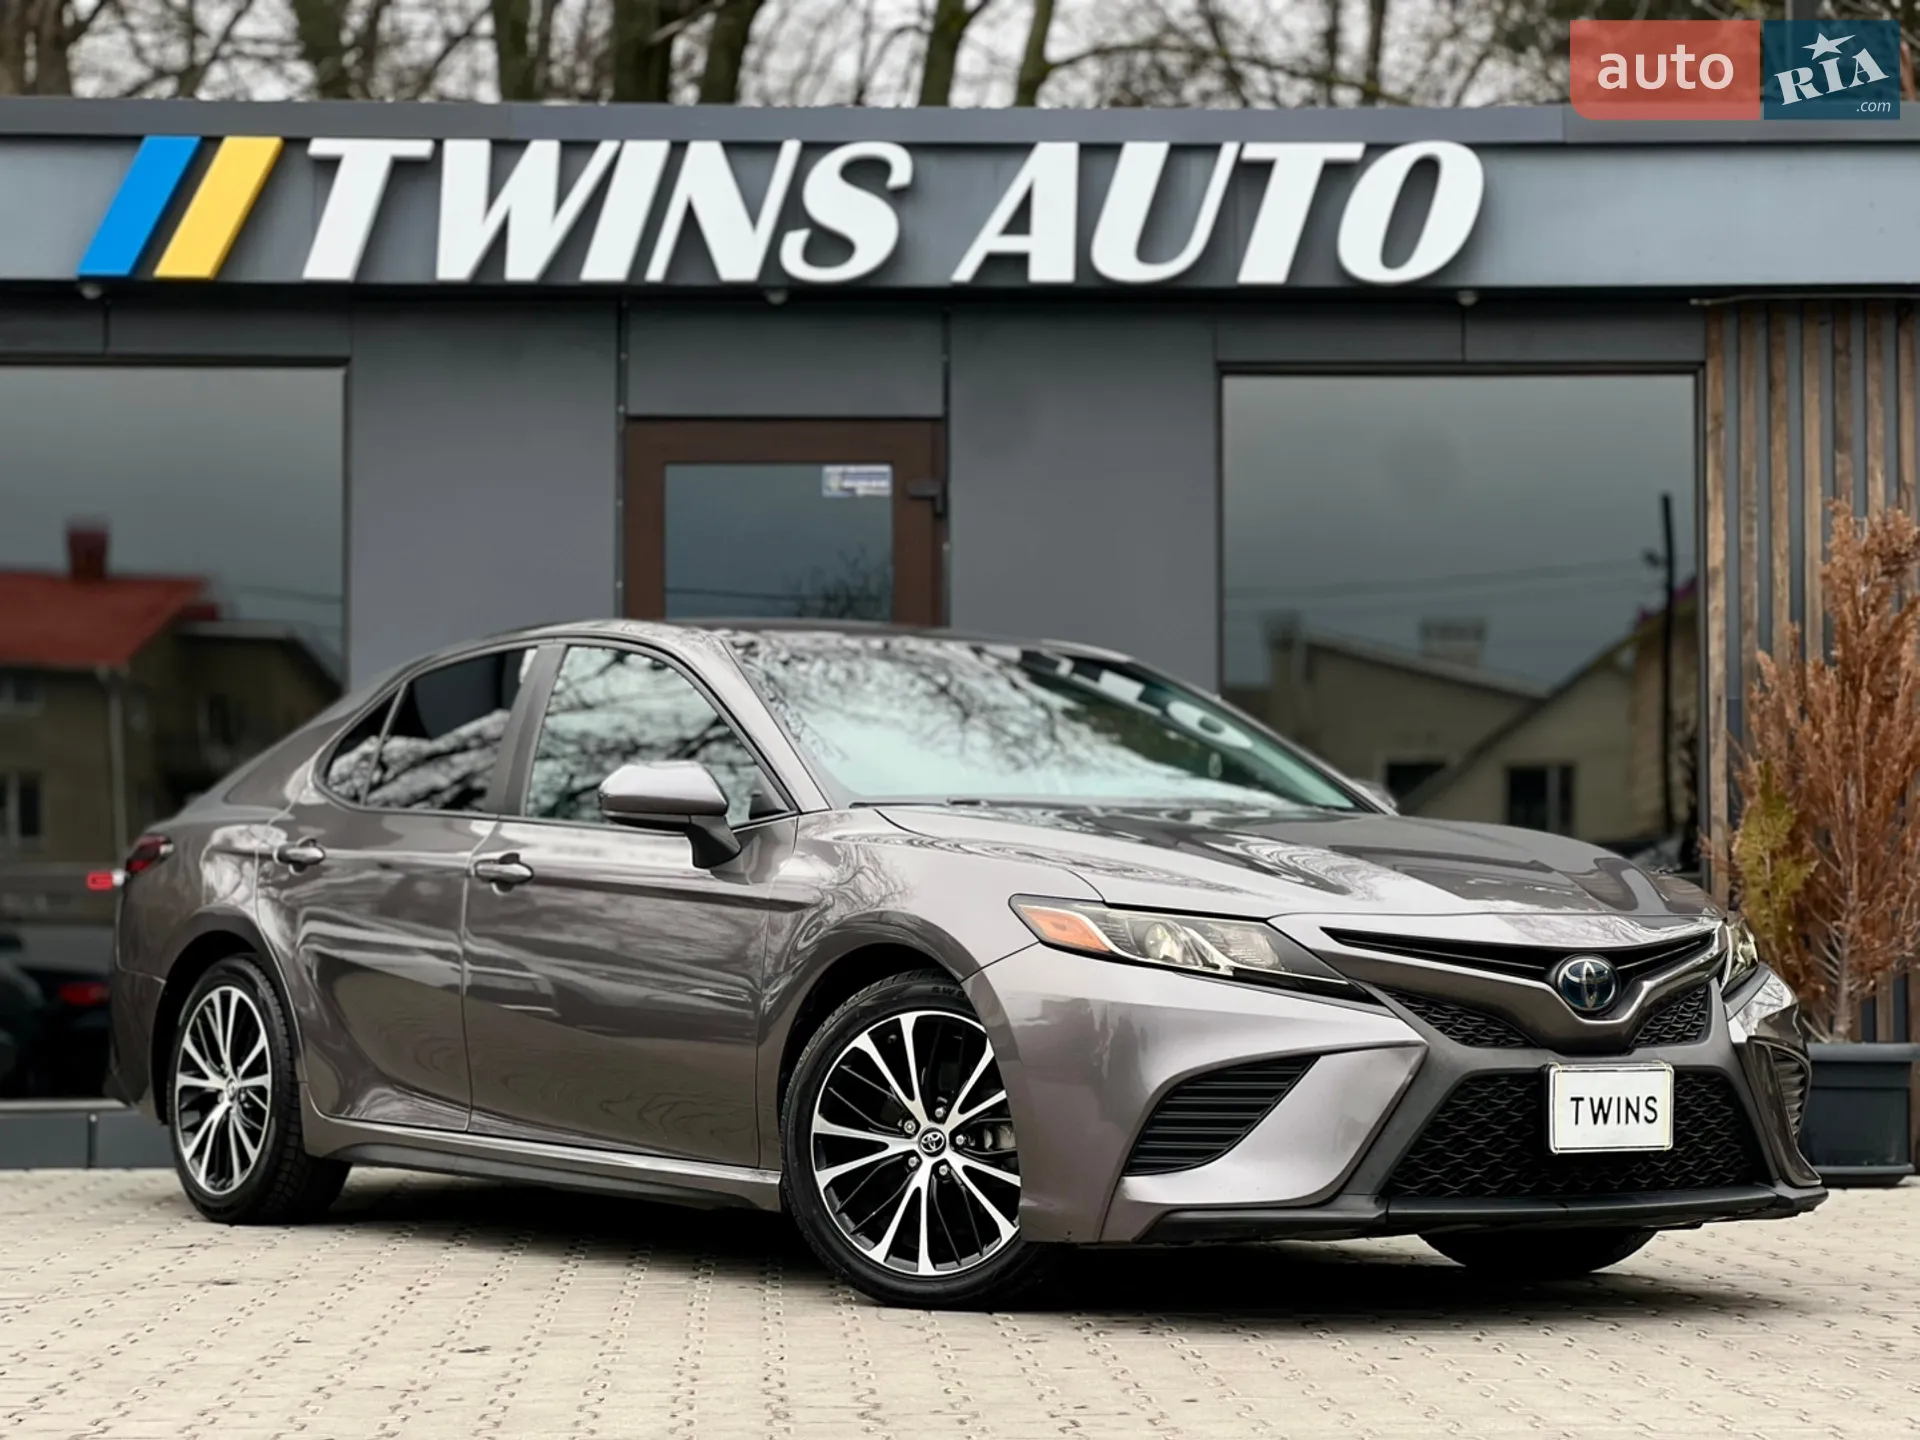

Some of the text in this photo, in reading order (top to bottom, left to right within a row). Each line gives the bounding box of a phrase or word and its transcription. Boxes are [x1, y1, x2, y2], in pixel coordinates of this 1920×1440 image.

[303, 138, 1484, 284] TWINS AUTO
[1570, 1095, 1658, 1126] TWINS
